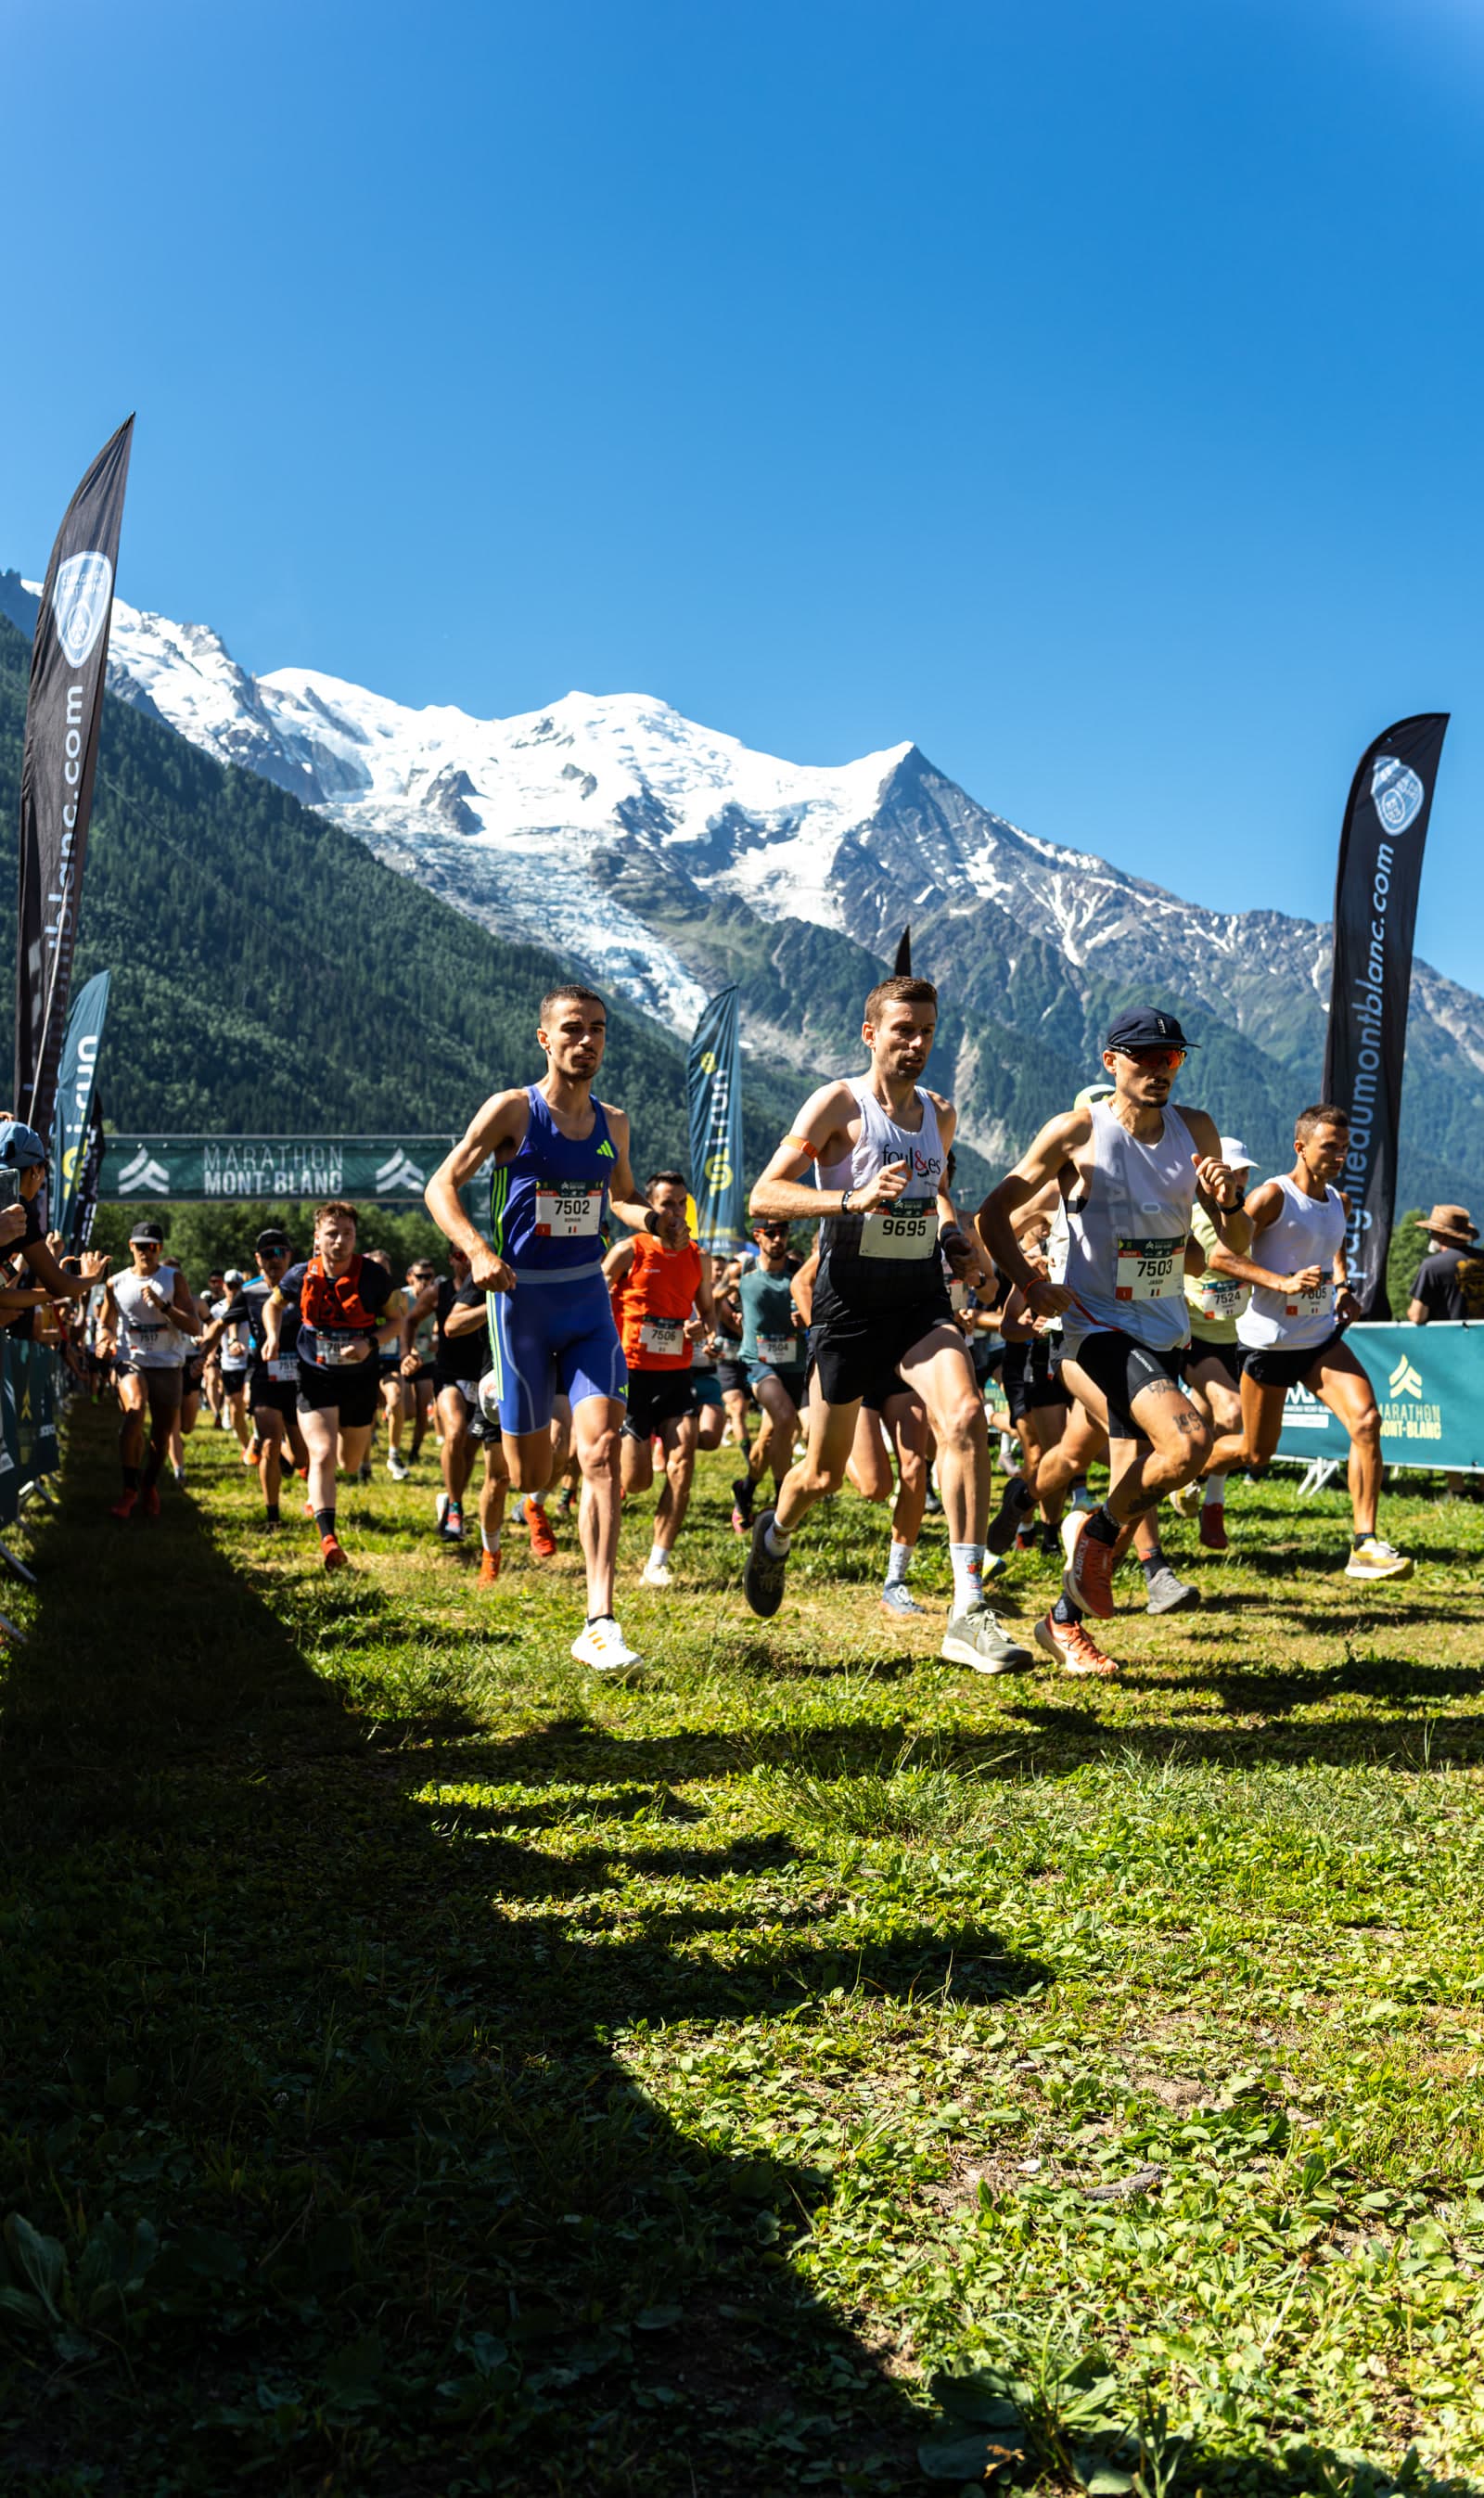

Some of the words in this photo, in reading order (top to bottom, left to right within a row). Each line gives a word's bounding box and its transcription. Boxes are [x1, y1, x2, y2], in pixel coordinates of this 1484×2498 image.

[203, 1146, 343, 1172] MARATHON
[555, 1199, 590, 1215] 7502
[882, 1219, 927, 1236] 9695
[1137, 1259, 1173, 1277] 7503
[1214, 1291, 1241, 1305] 7524
[767, 1342, 788, 1352] 7504
